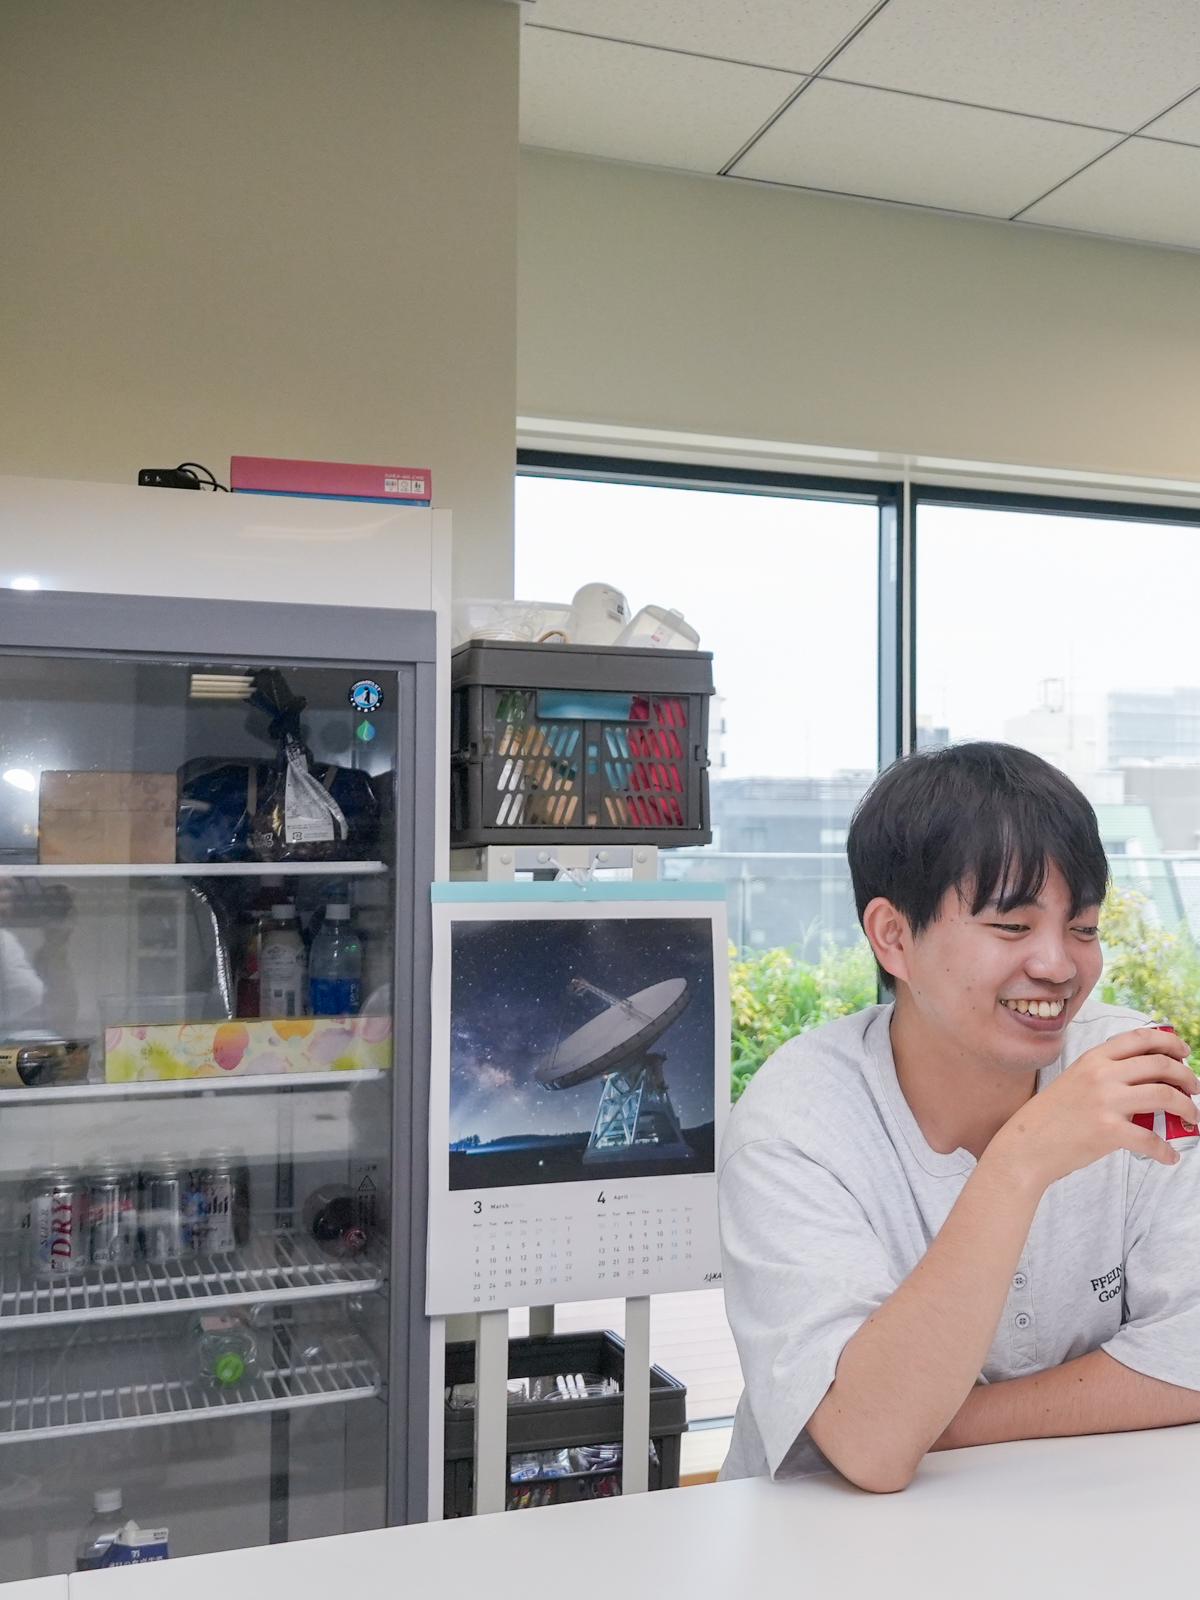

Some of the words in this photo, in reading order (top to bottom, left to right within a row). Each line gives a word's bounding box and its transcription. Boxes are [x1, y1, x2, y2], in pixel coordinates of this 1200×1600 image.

[597, 1190, 606, 1204] 4
[473, 1200, 482, 1214] 3
[51, 1199, 72, 1258] DRY
[1098, 1284, 1122, 1303] Goo
